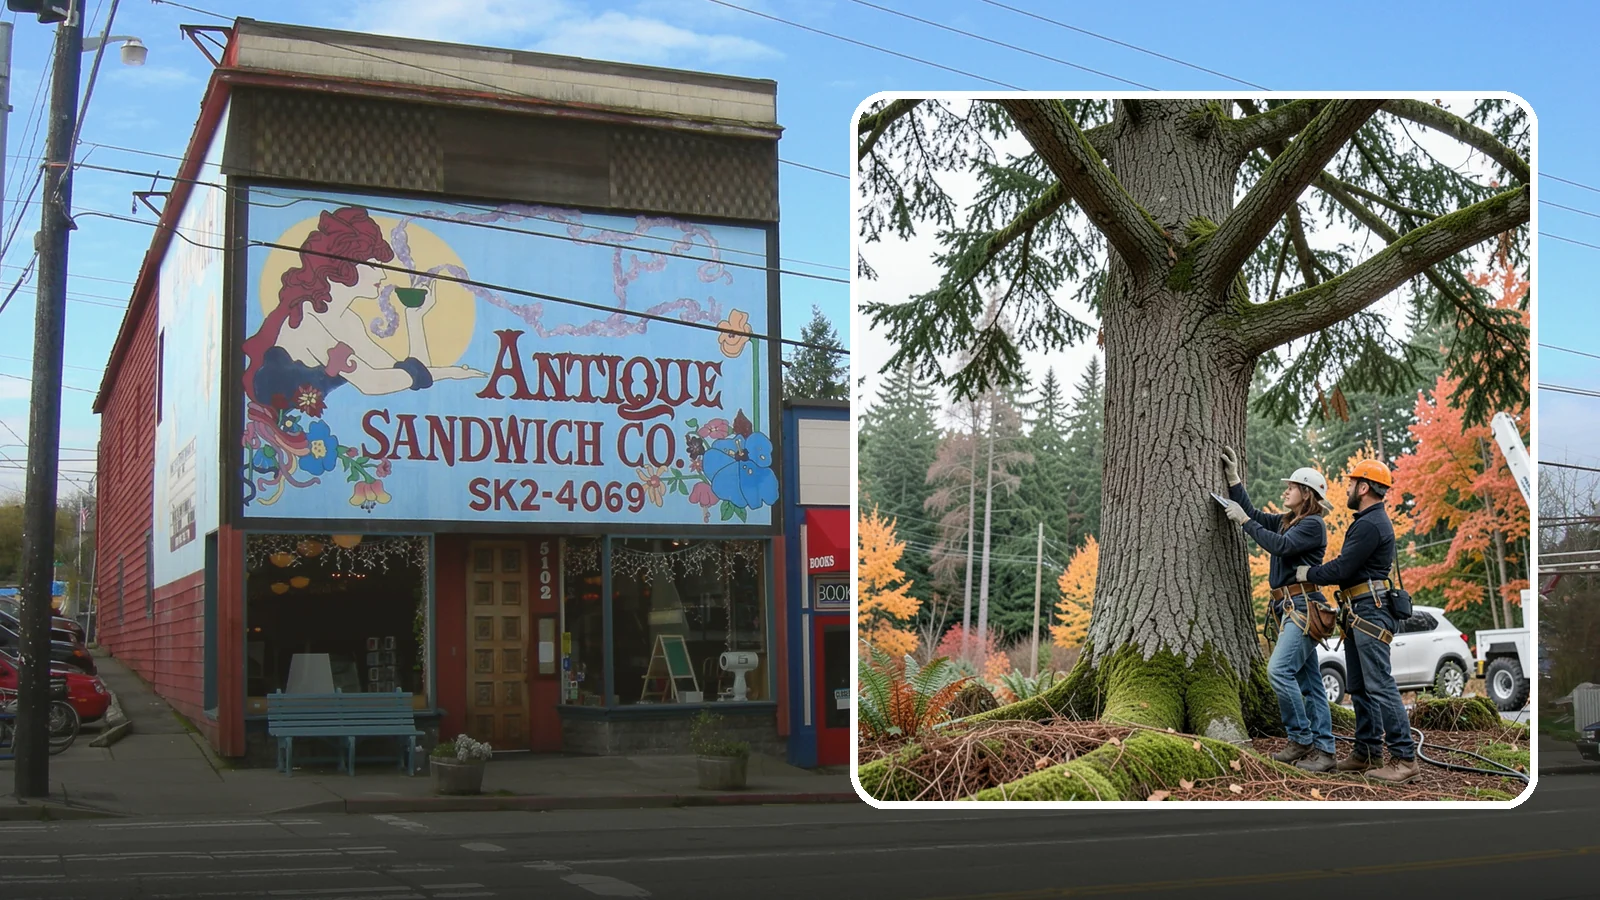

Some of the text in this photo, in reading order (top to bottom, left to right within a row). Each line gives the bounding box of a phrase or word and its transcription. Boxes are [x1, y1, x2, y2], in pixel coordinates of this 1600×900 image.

[475, 329, 724, 420] ANTIQUE
[361, 408, 685, 468] SANDWICH CO.
[468, 477, 646, 512] SK2-4069
[539, 541, 551, 599] 5102
[809, 555, 835, 569] BOOKS
